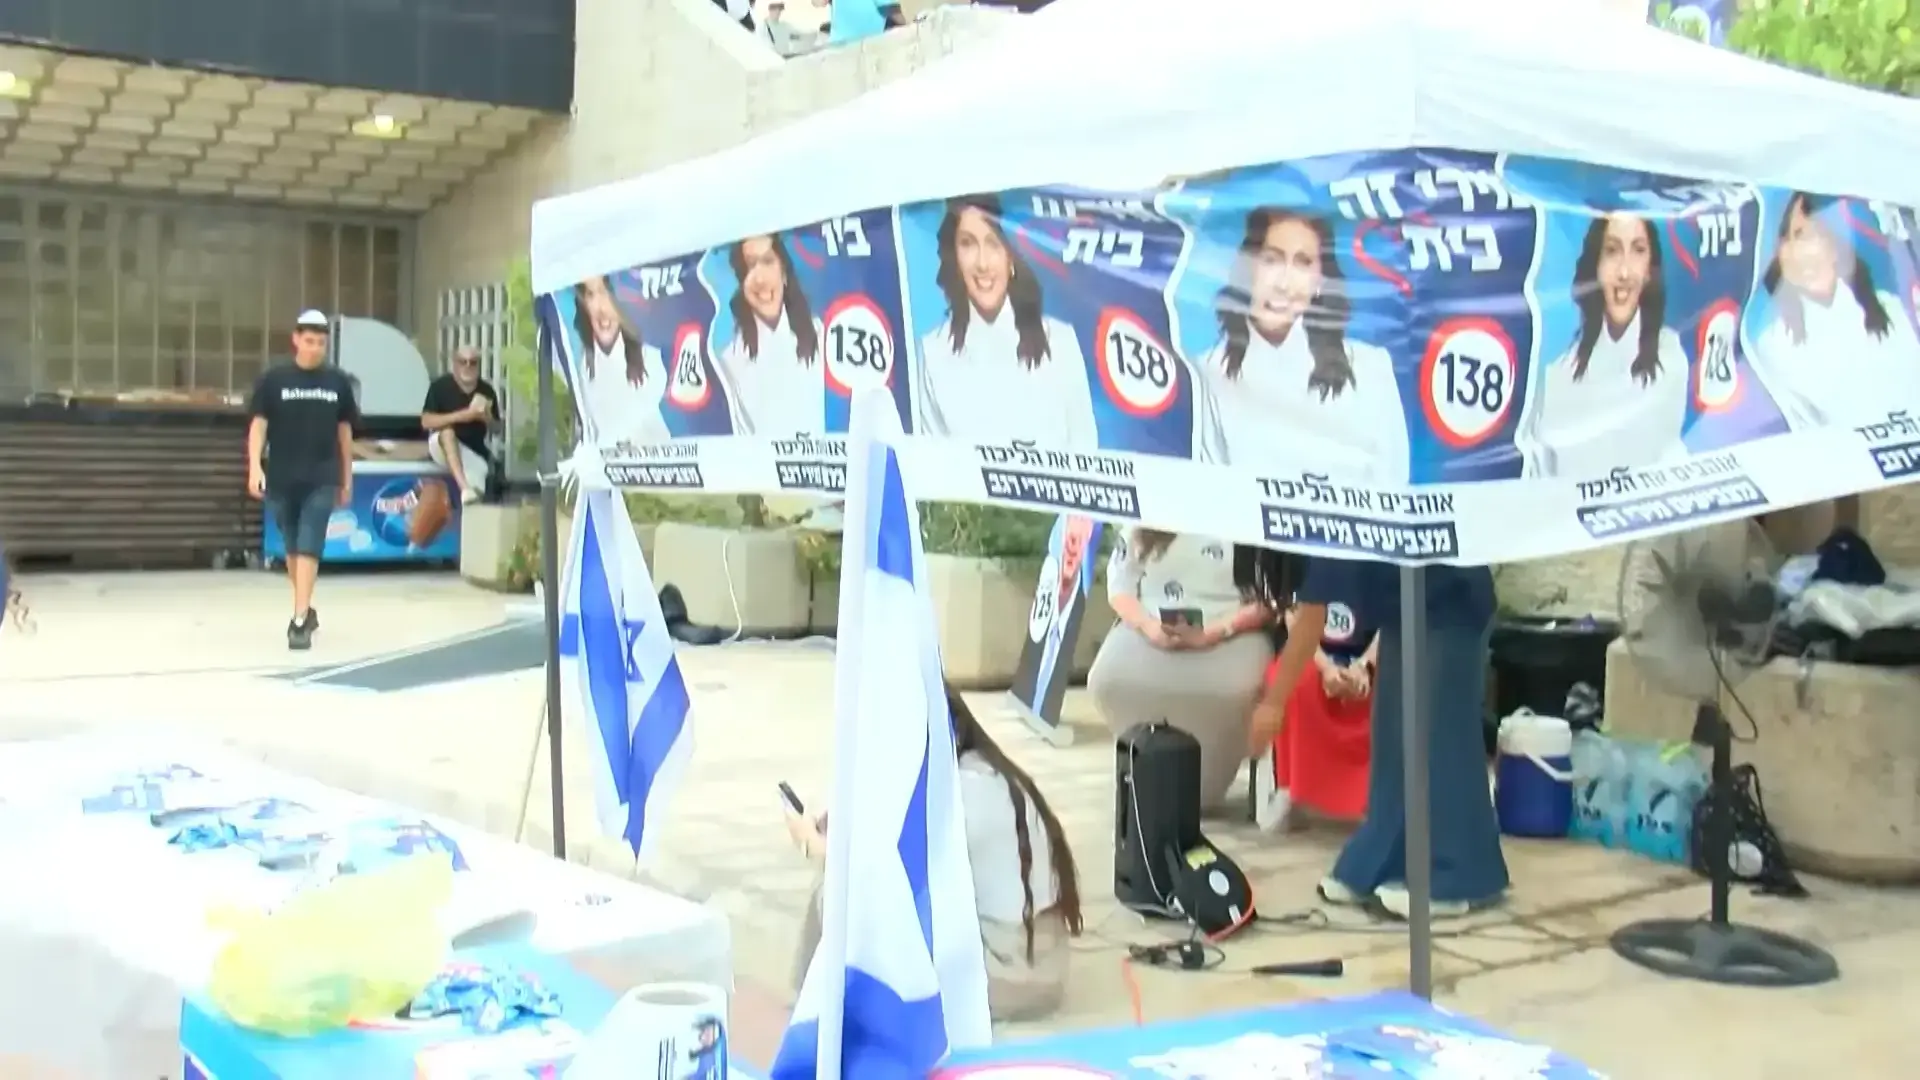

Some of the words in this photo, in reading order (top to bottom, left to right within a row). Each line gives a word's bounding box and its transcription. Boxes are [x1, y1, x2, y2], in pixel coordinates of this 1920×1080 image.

[1329, 173, 1404, 220] זה
[1062, 228, 1144, 268] בית
[1402, 223, 1502, 272] בית
[830, 323, 888, 374] 138
[1110, 331, 1169, 388] 138
[1439, 351, 1504, 413] 138
[974, 440, 1044, 468] הליכוד
[1045, 450, 1072, 471] את
[1075, 453, 1136, 479] אוהבים
[988, 471, 1021, 498] רגב
[1020, 475, 1060, 502] מירי
[1058, 479, 1135, 513] מצביעים
[1255, 473, 1338, 505] הליכוד
[1576, 465, 1638, 500] הליכוד
[1341, 486, 1373, 512] את
[1376, 491, 1455, 516] אוהבים
[1268, 508, 1308, 540] רגב
[1308, 515, 1355, 547] מירי
[1355, 522, 1452, 555] מצביעים
